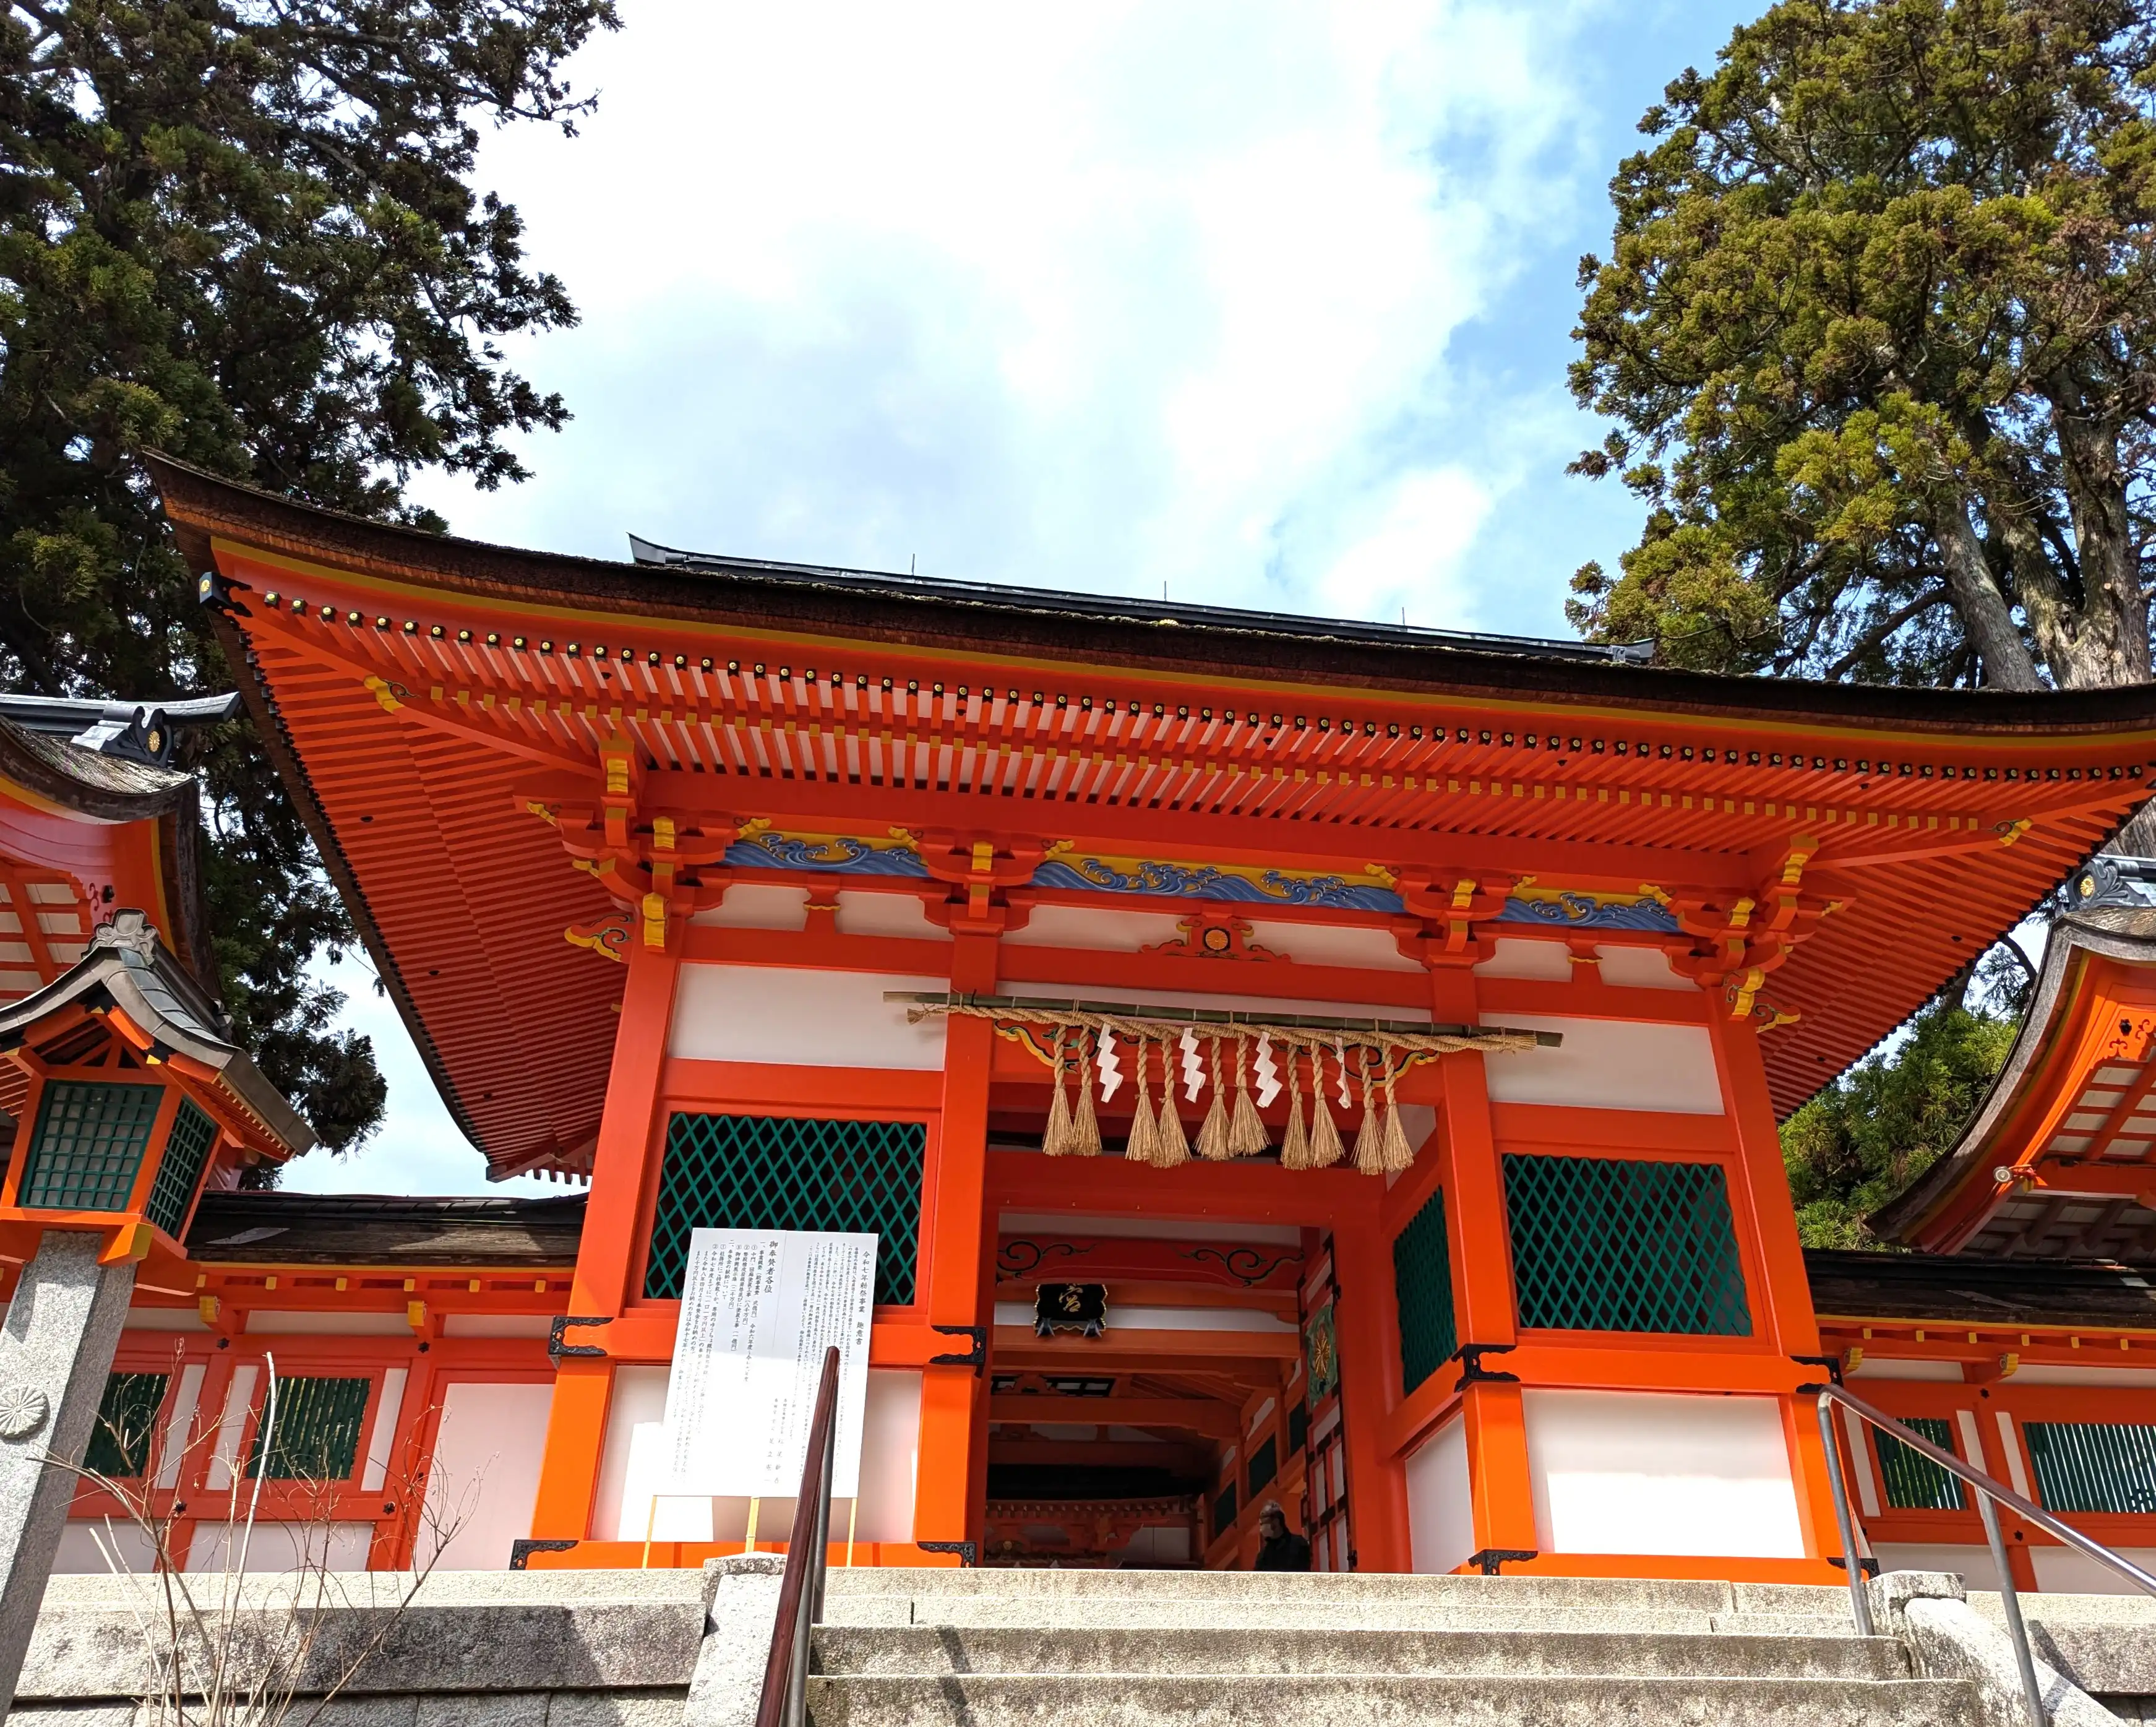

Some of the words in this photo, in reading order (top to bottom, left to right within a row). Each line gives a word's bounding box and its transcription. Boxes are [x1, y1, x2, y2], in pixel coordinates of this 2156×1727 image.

[763, 1240, 778, 1293] 御奉賛者各位
